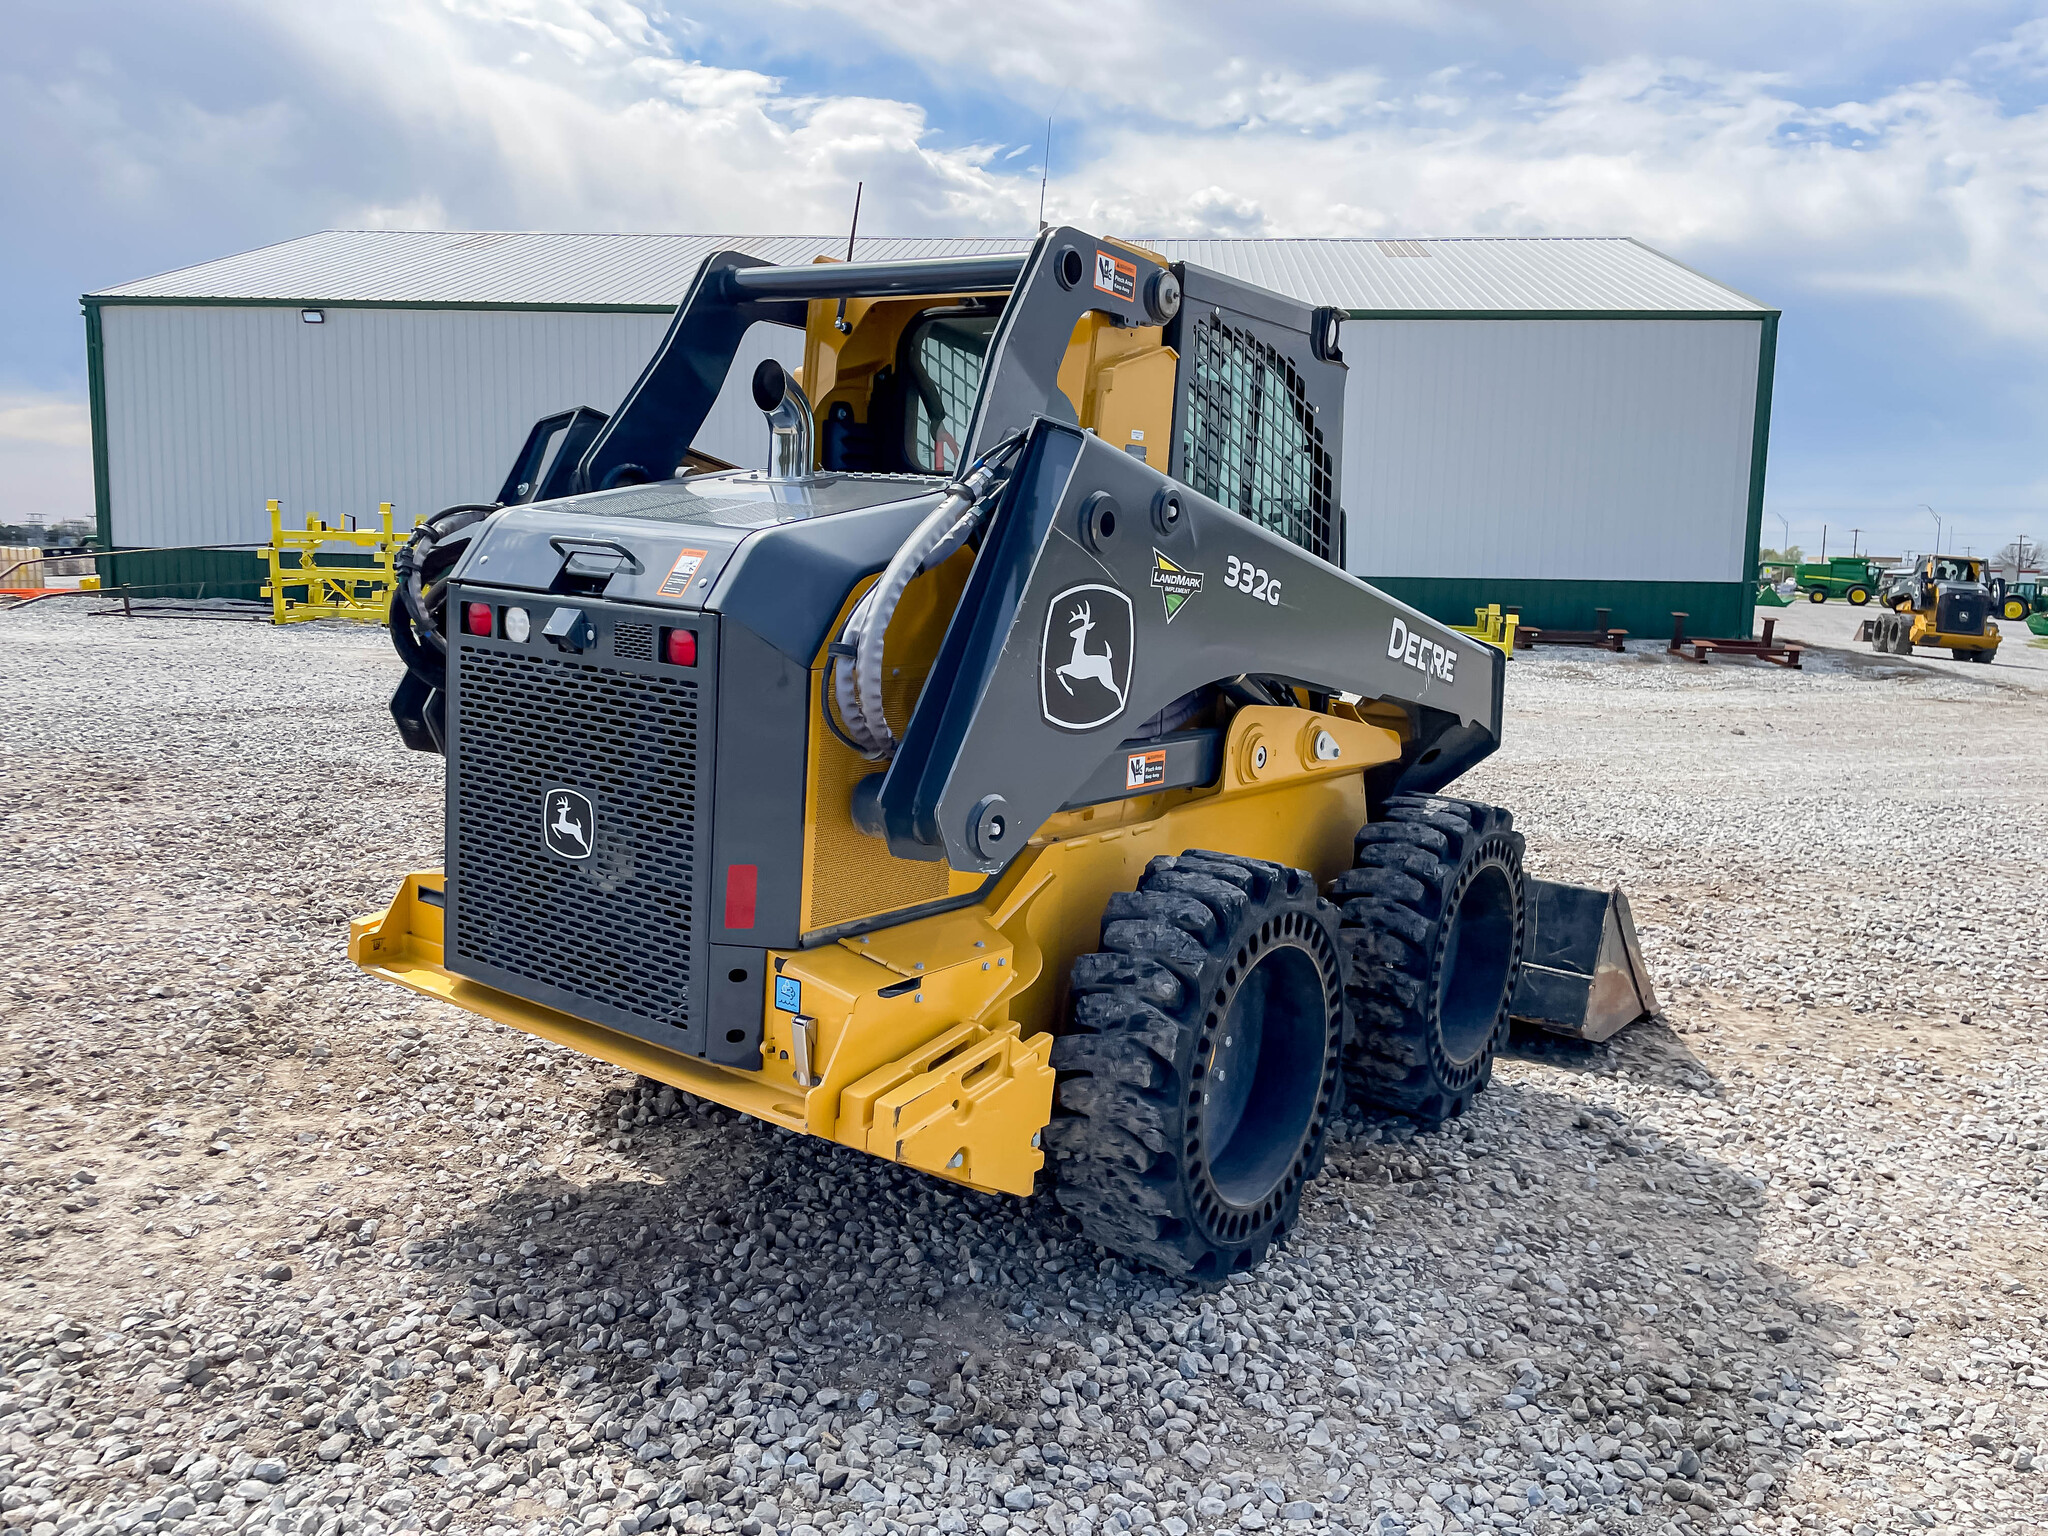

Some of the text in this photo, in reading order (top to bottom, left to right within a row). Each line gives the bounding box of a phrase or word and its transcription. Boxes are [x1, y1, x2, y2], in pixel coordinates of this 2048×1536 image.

[1153, 571, 1201, 588] LANDMARK
[1223, 555, 1282, 606] 332G
[1164, 585, 1191, 595] IMPLEMENT
